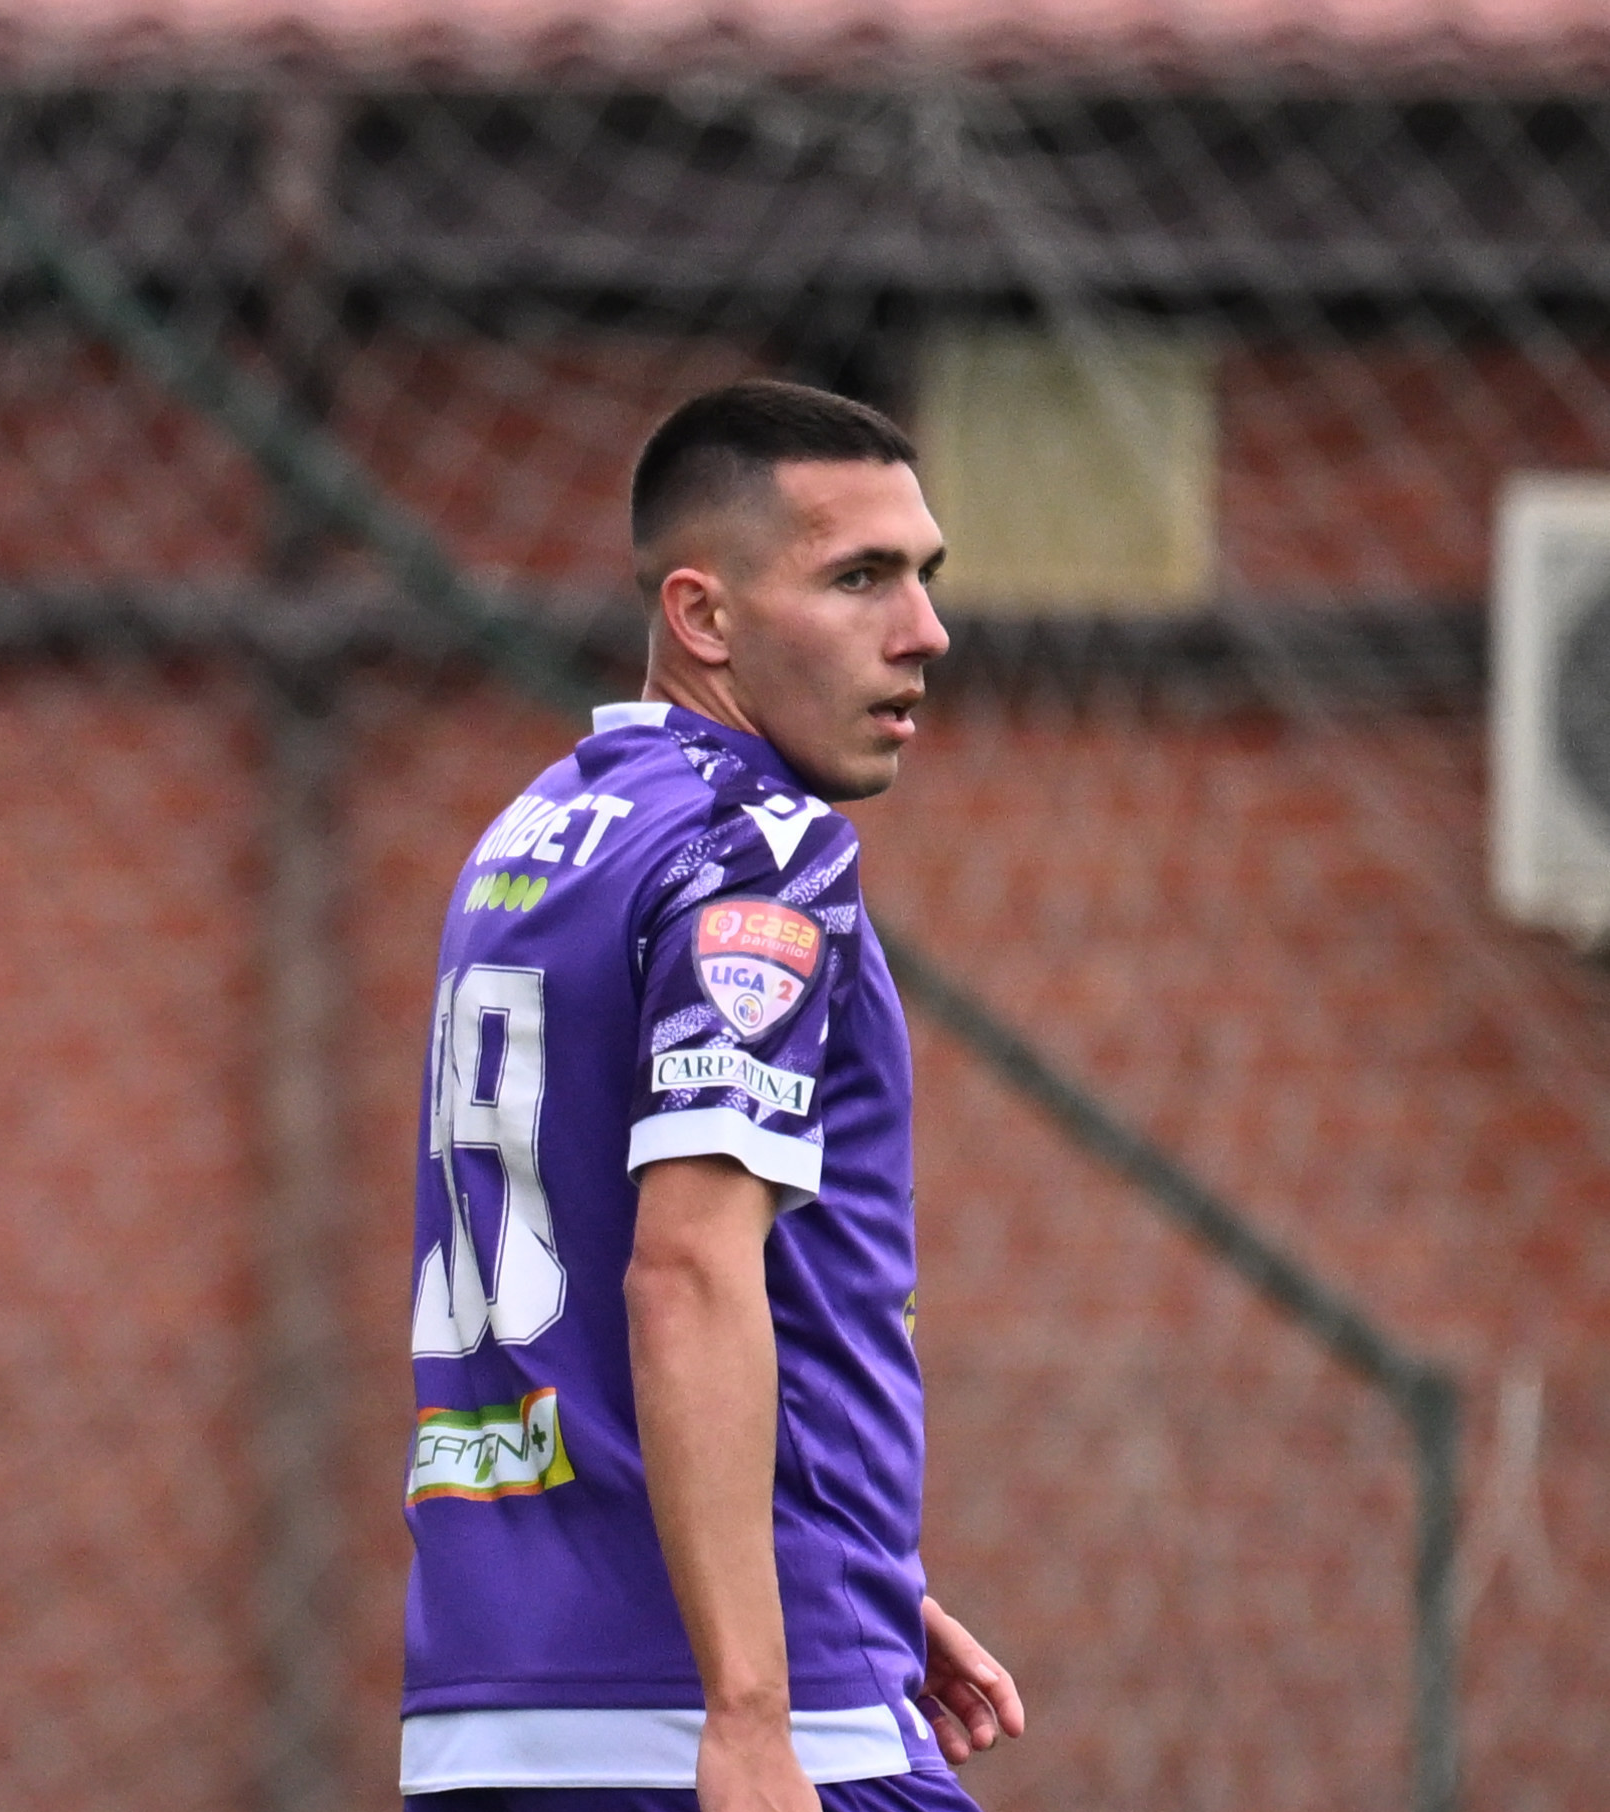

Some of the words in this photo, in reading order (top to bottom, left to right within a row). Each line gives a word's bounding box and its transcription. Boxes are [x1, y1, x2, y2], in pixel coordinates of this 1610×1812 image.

[745, 914, 817, 949] casa
[711, 965, 766, 995] LIGA
[777, 979, 794, 1003] 2
[658, 1055, 804, 1111] CARPATINA
